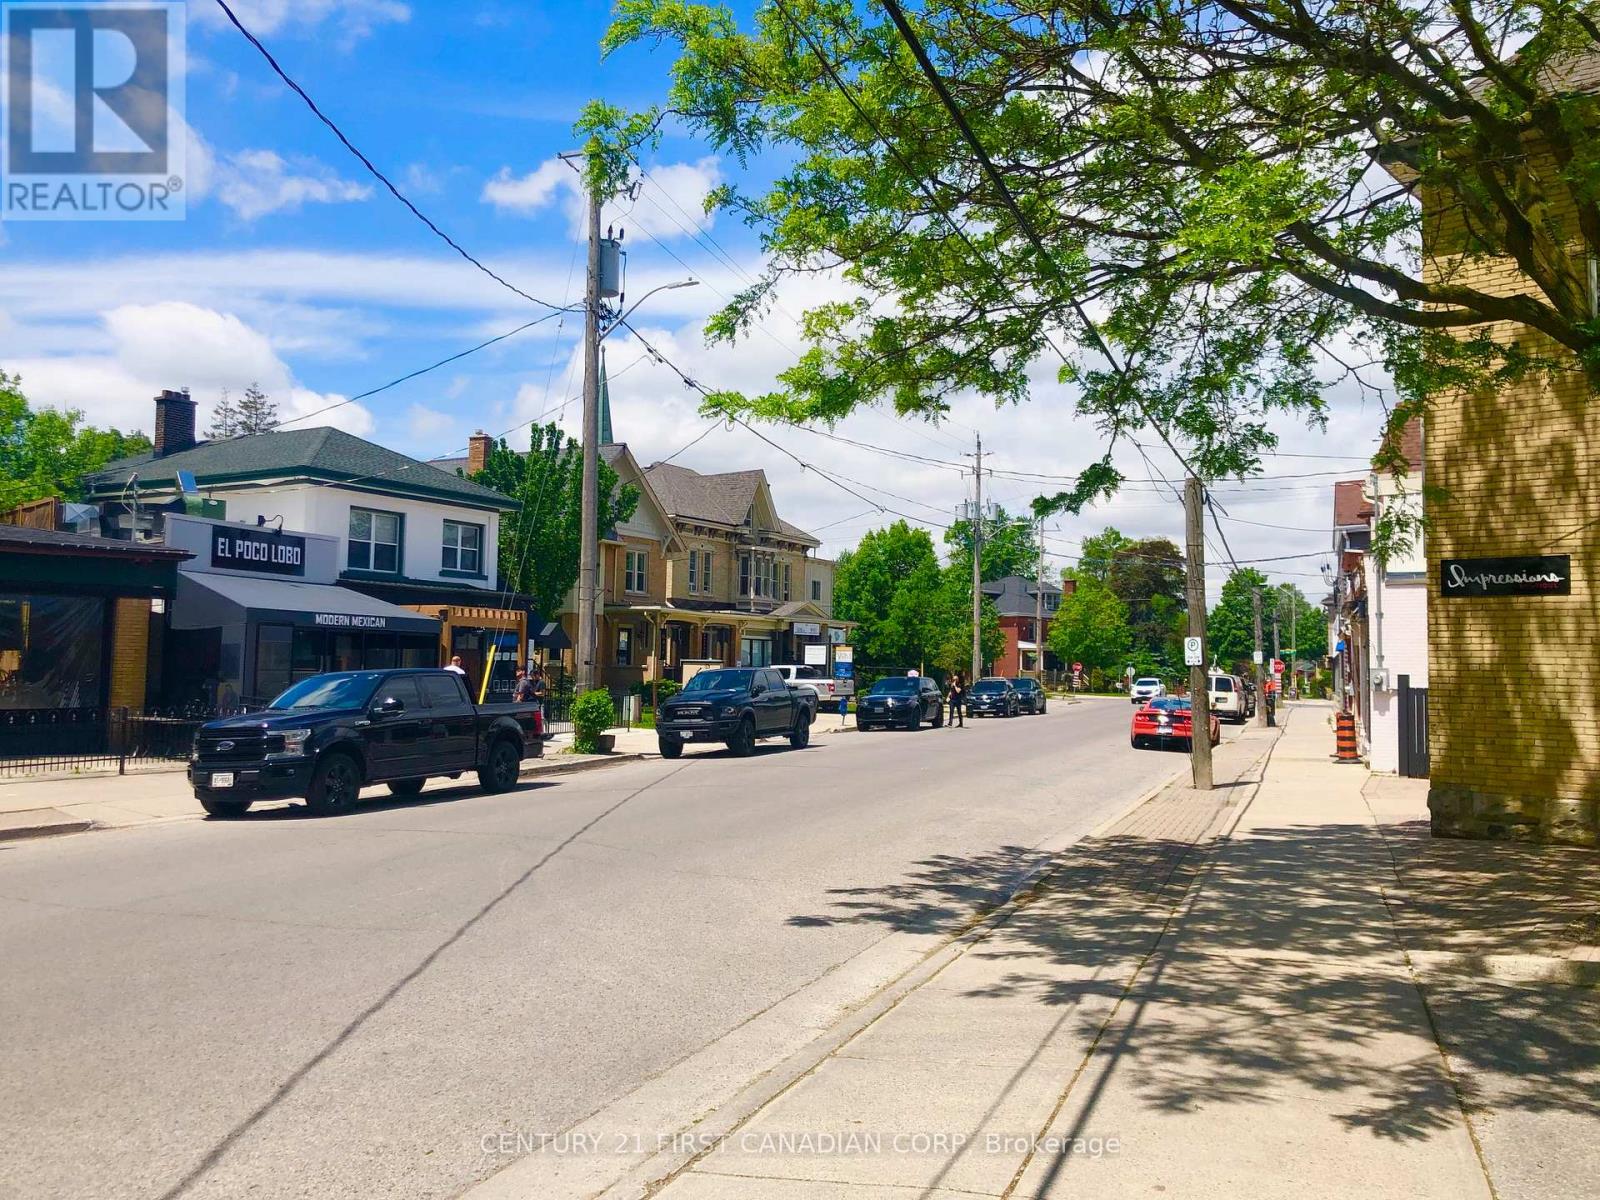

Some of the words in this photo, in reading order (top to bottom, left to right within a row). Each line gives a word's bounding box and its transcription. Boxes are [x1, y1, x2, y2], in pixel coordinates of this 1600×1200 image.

[217, 537, 232, 558] EL
[235, 540, 268, 561] POCO
[271, 544, 301, 565] LOBO
[1447, 564, 1565, 590] Impressions
[315, 613, 350, 627] MODERN
[351, 615, 386, 628] MEXICAN
